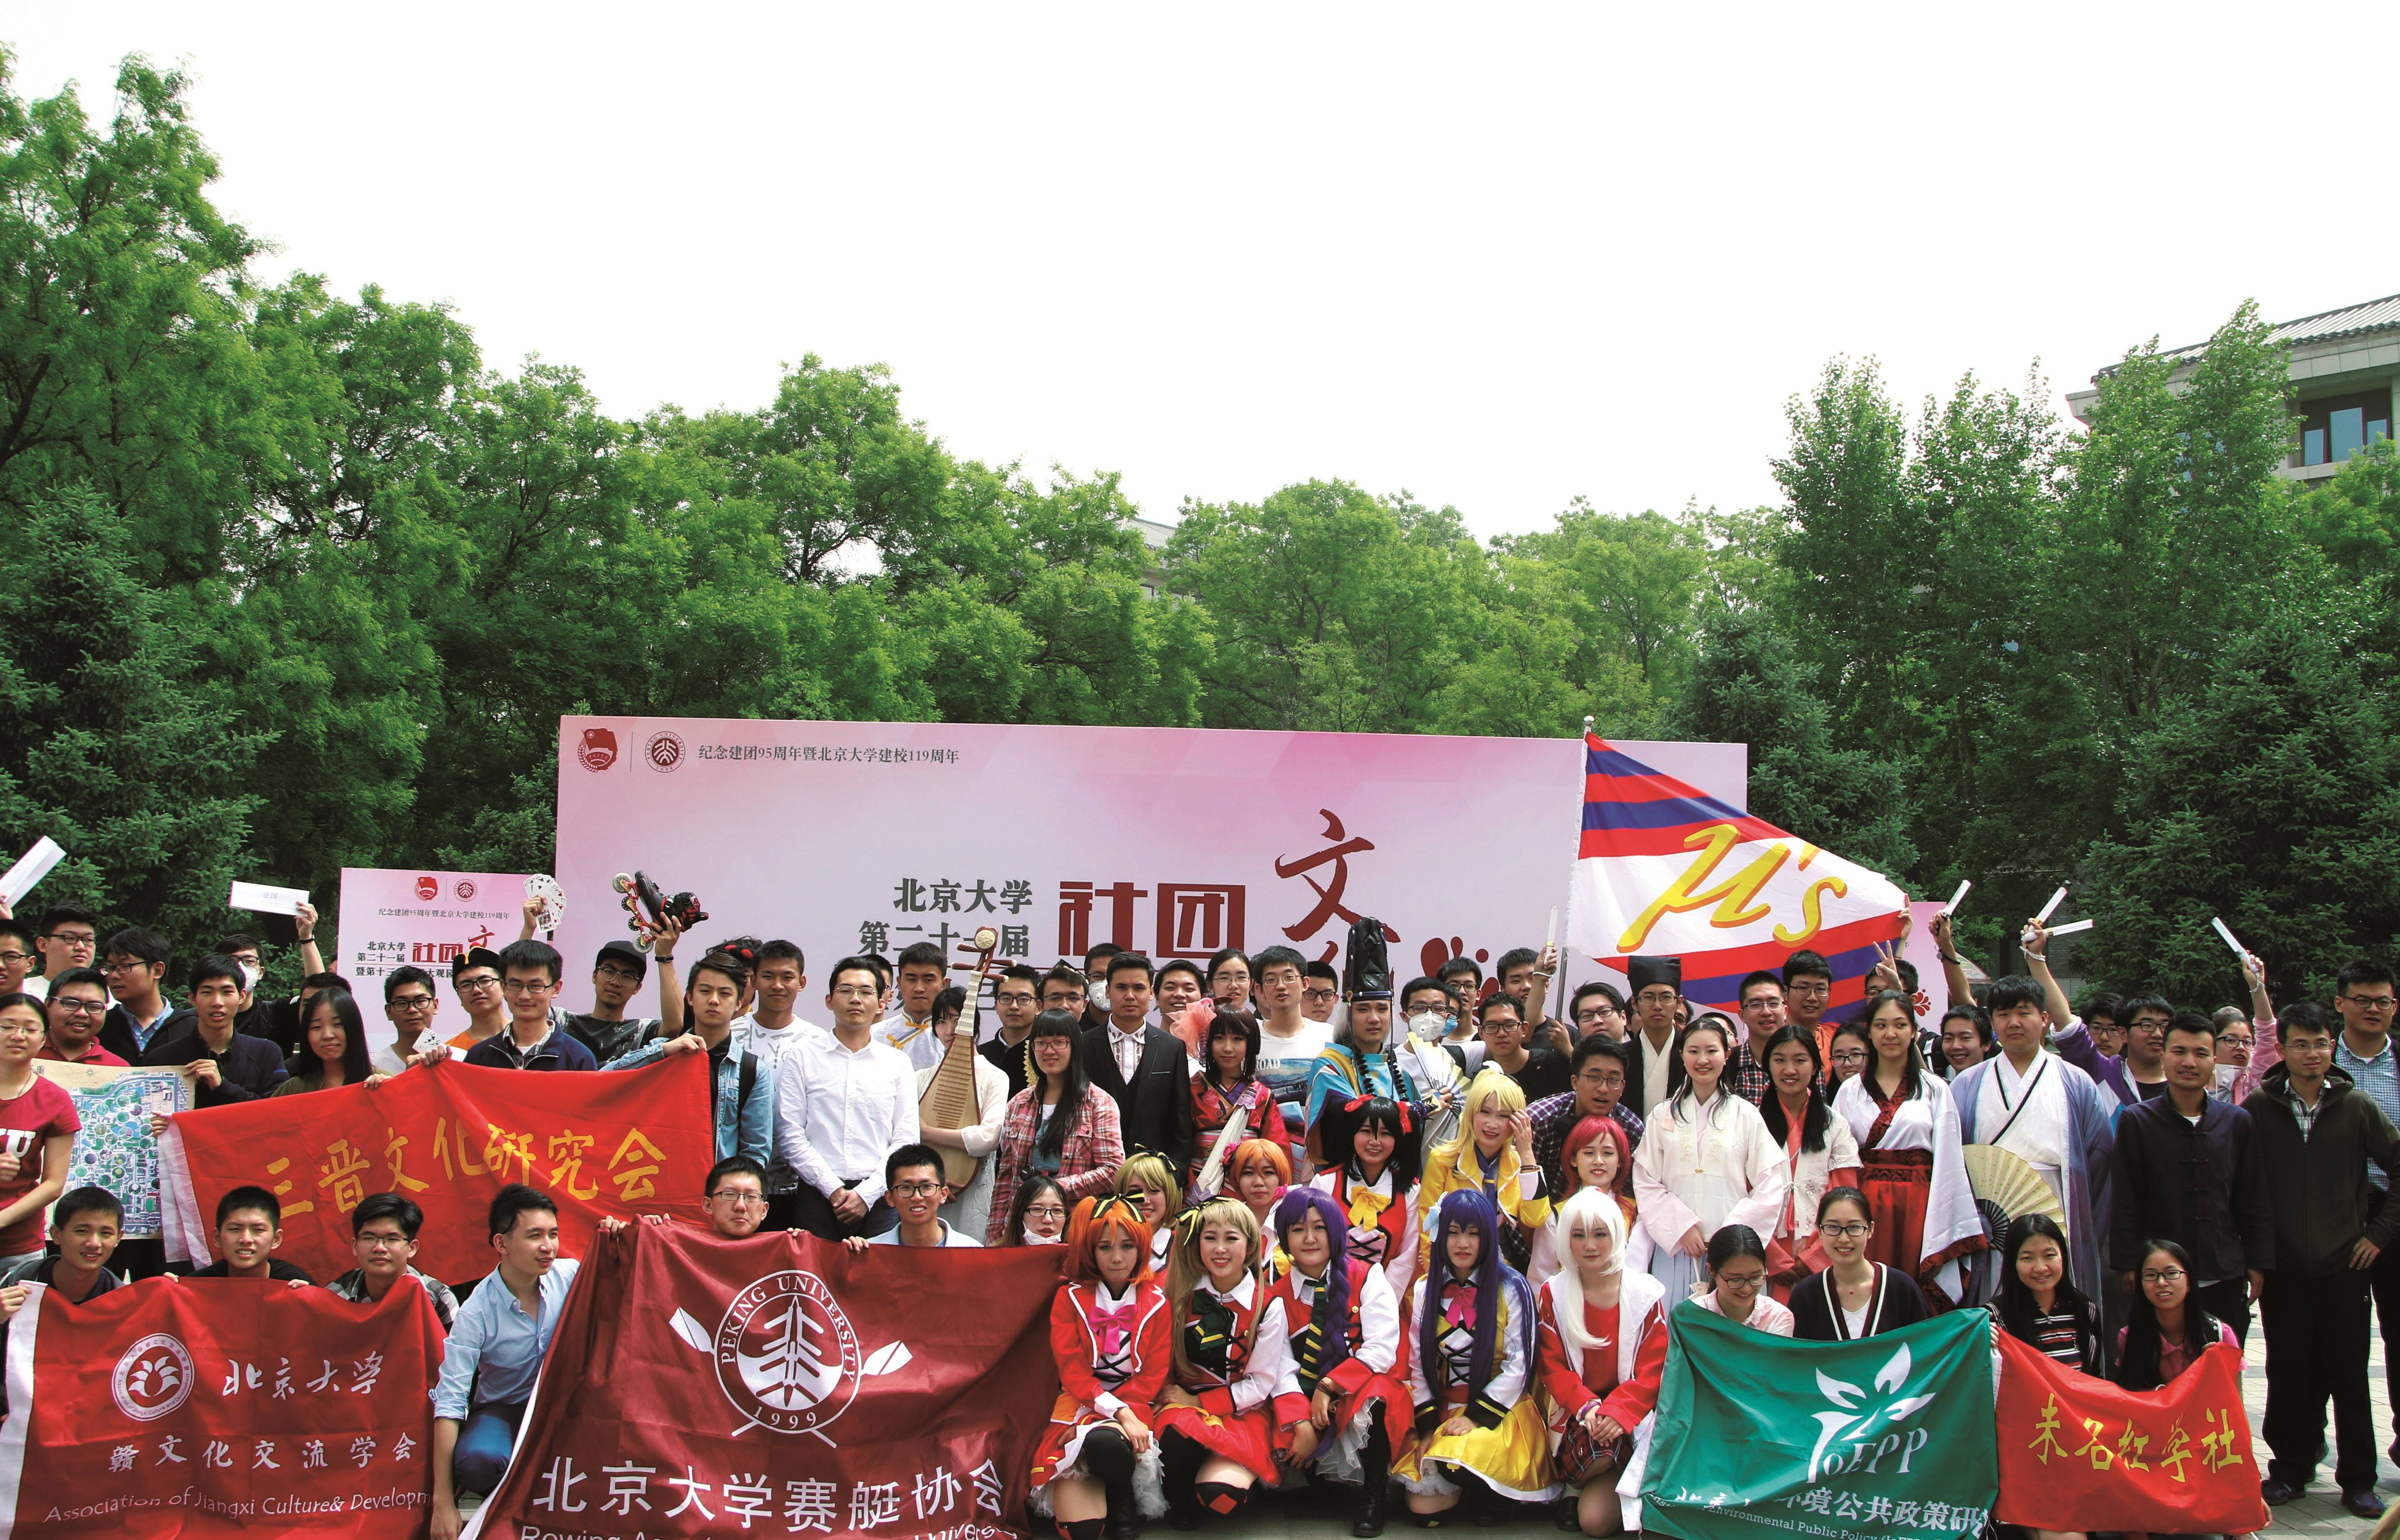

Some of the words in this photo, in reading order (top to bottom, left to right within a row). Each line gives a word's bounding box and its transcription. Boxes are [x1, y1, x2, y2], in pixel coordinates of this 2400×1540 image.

[646, 736, 657, 760] PEKING
[660, 733, 684, 760] UNIVERSITY
[699, 745, 959, 764] 纪念建团95周年暨北京大学建校119周年
[893, 878, 1032, 915] 北京大学
[1058, 881, 1245, 959] 社团
[1275, 808, 1401, 943] 文
[379, 908, 510, 920] 纪念建团95周年暨北京大学建校119周年
[357, 952, 405, 963] 第二十一届
[367, 941, 406, 951] 北京大学
[412, 942, 463, 963] 社团
[0, 1128, 36, 1158] U
[266, 1117, 666, 1220] 三晋文化研究会
[721, 1286, 767, 1365] PEKING
[777, 1275, 856, 1383] UNIVERSITY
[117, 1379, 129, 1406] Association
[132, 1407, 148, 1416] Jiangxi
[148, 1405, 166, 1415] Culture
[166, 1399, 176, 1408] and
[175, 1373, 190, 1402] Development
[753, 1406, 817, 1430] 1999
[108, 1432, 418, 1472] 赣文化交流学会
[2028, 1392, 2243, 1483] 未名红学社
[43, 1493, 161, 1523] Association
[168, 1485, 195, 1505] of
[195, 1491, 255, 1520] Jiangxi
[350, 1486, 434, 1511] Developm
[532, 1456, 1005, 1534] 北京大学赛艇协会
[1798, 1521, 1837, 1538] Public
